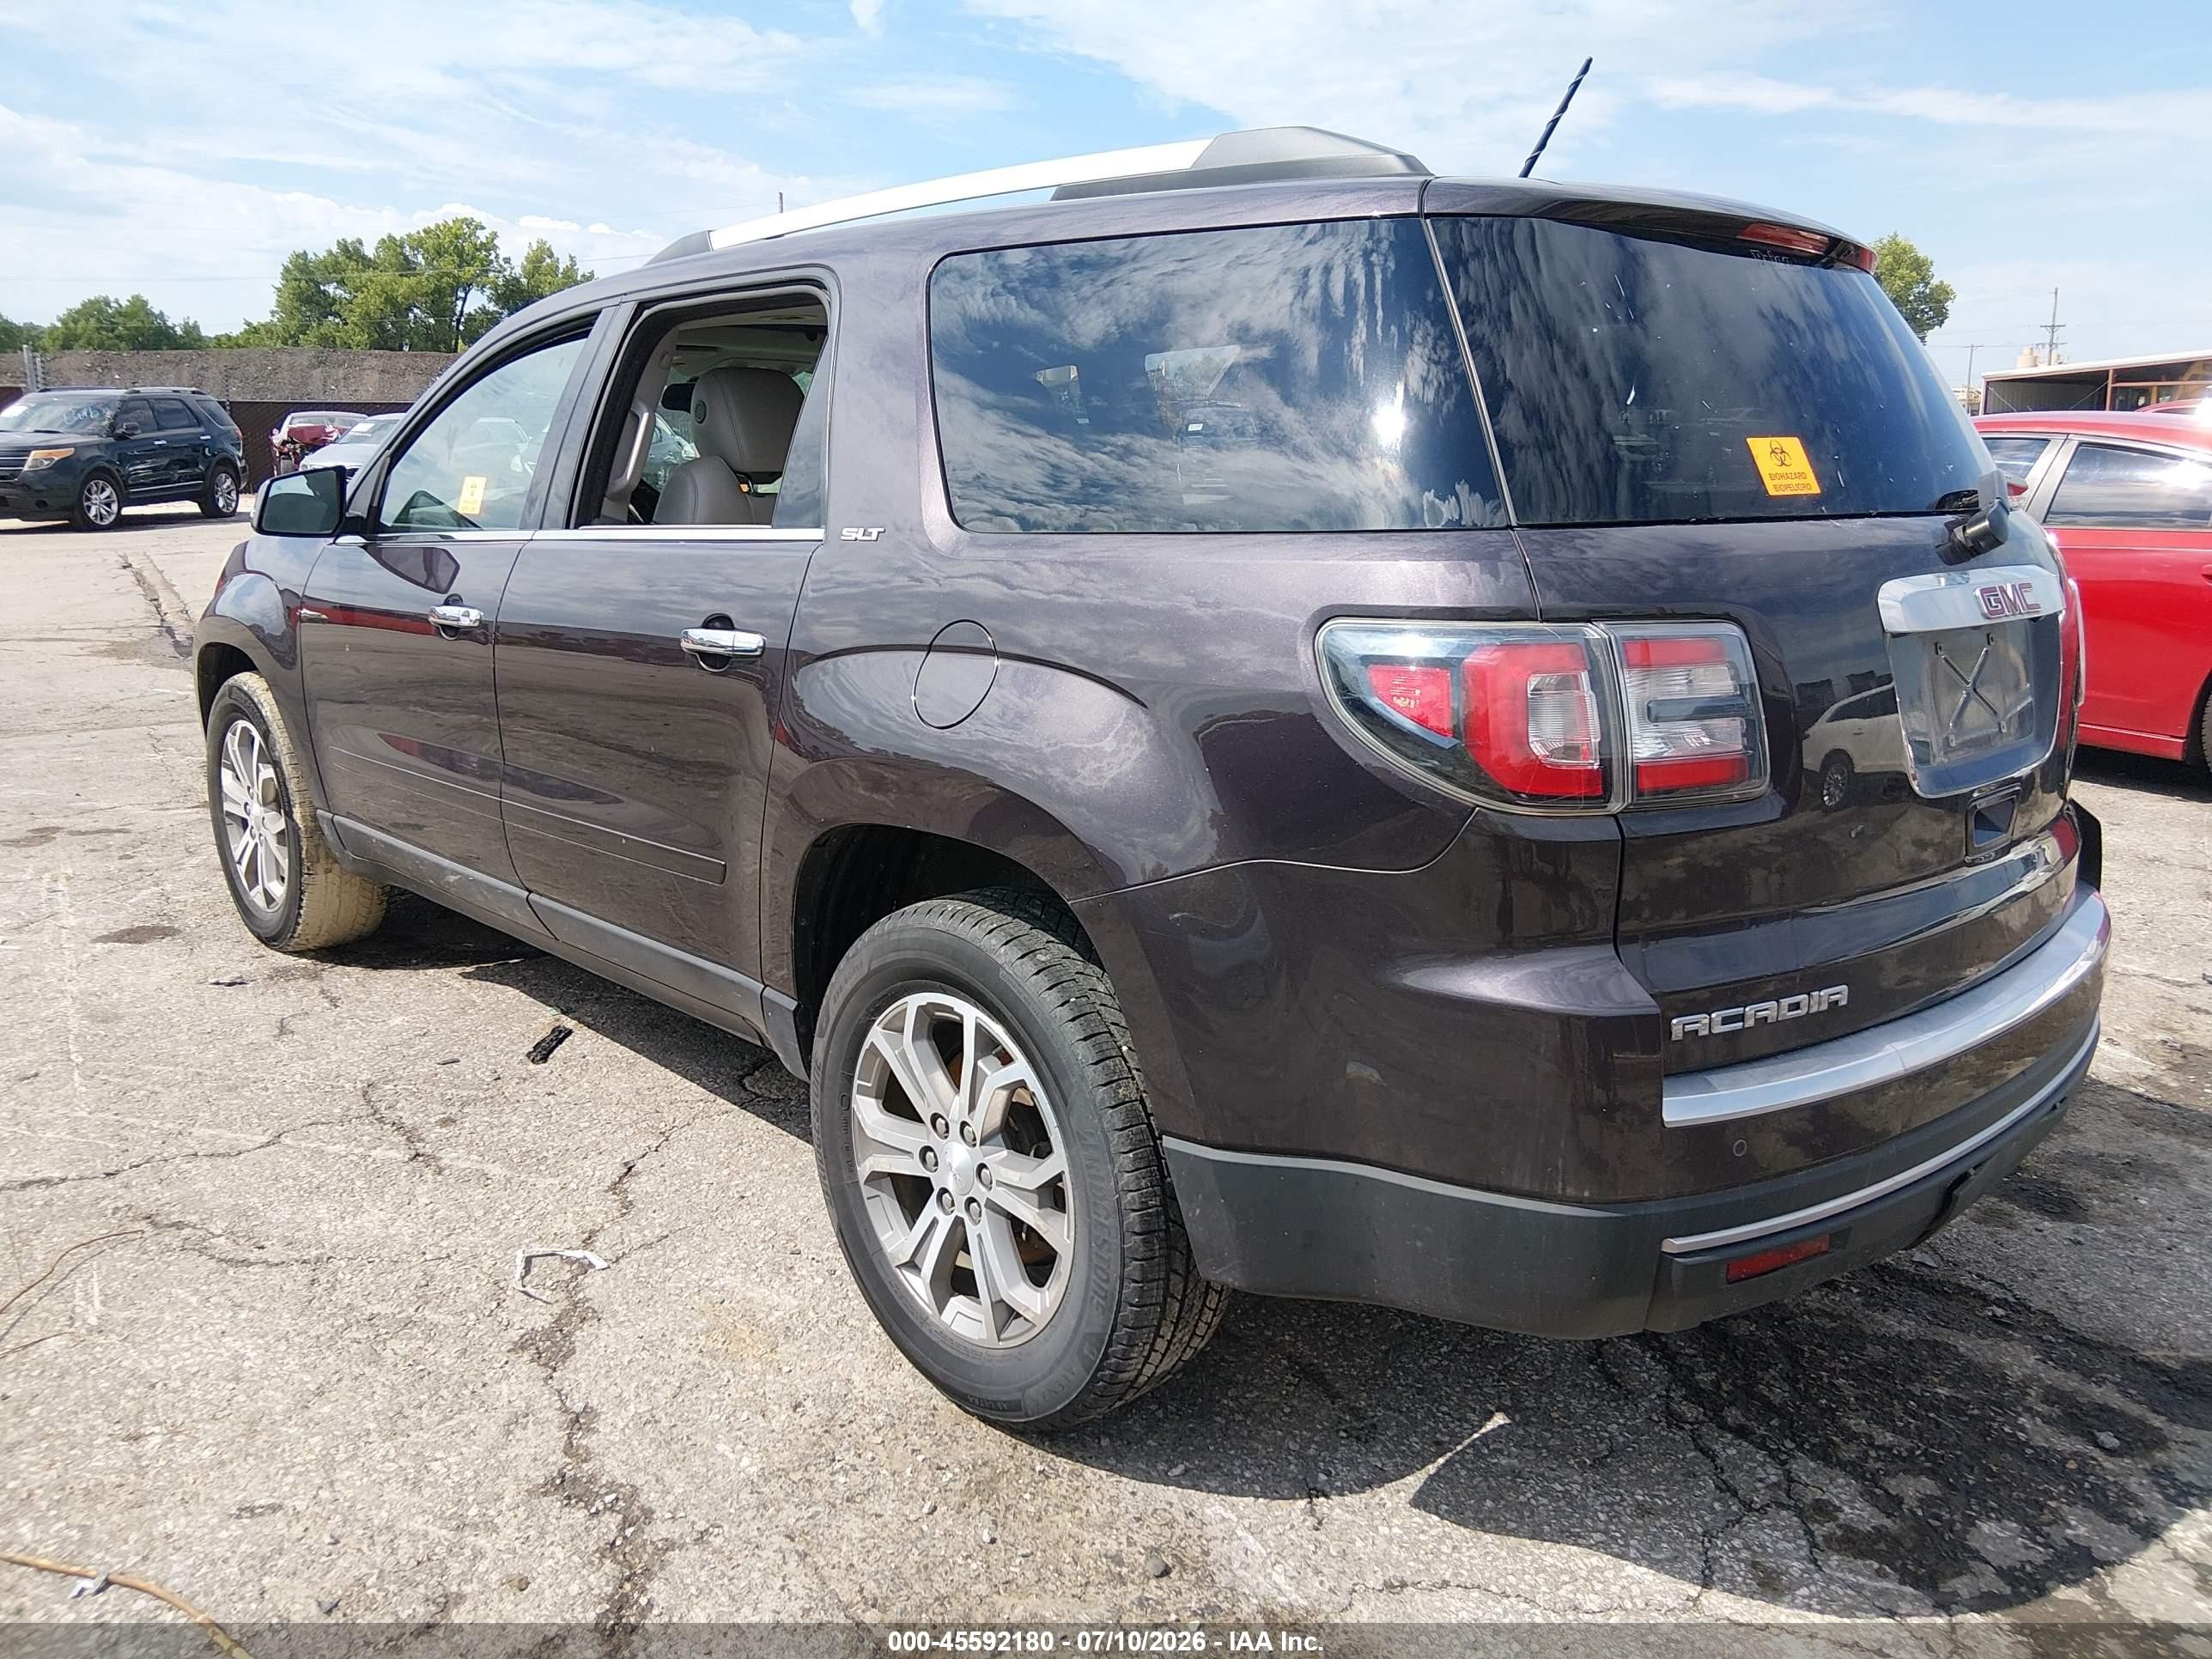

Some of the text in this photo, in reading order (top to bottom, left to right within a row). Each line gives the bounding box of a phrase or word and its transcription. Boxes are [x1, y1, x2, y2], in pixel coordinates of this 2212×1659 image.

[1768, 471, 1808, 481] BIOHAZARD
[1772, 483, 1812, 492] BIOPELIGRO
[840, 527, 886, 542] SLT
[1976, 582, 2043, 617] GMC
[1670, 984, 1848, 1041] ACADIA
[1076, 1128, 1113, 1312] BRIDGESTONE
